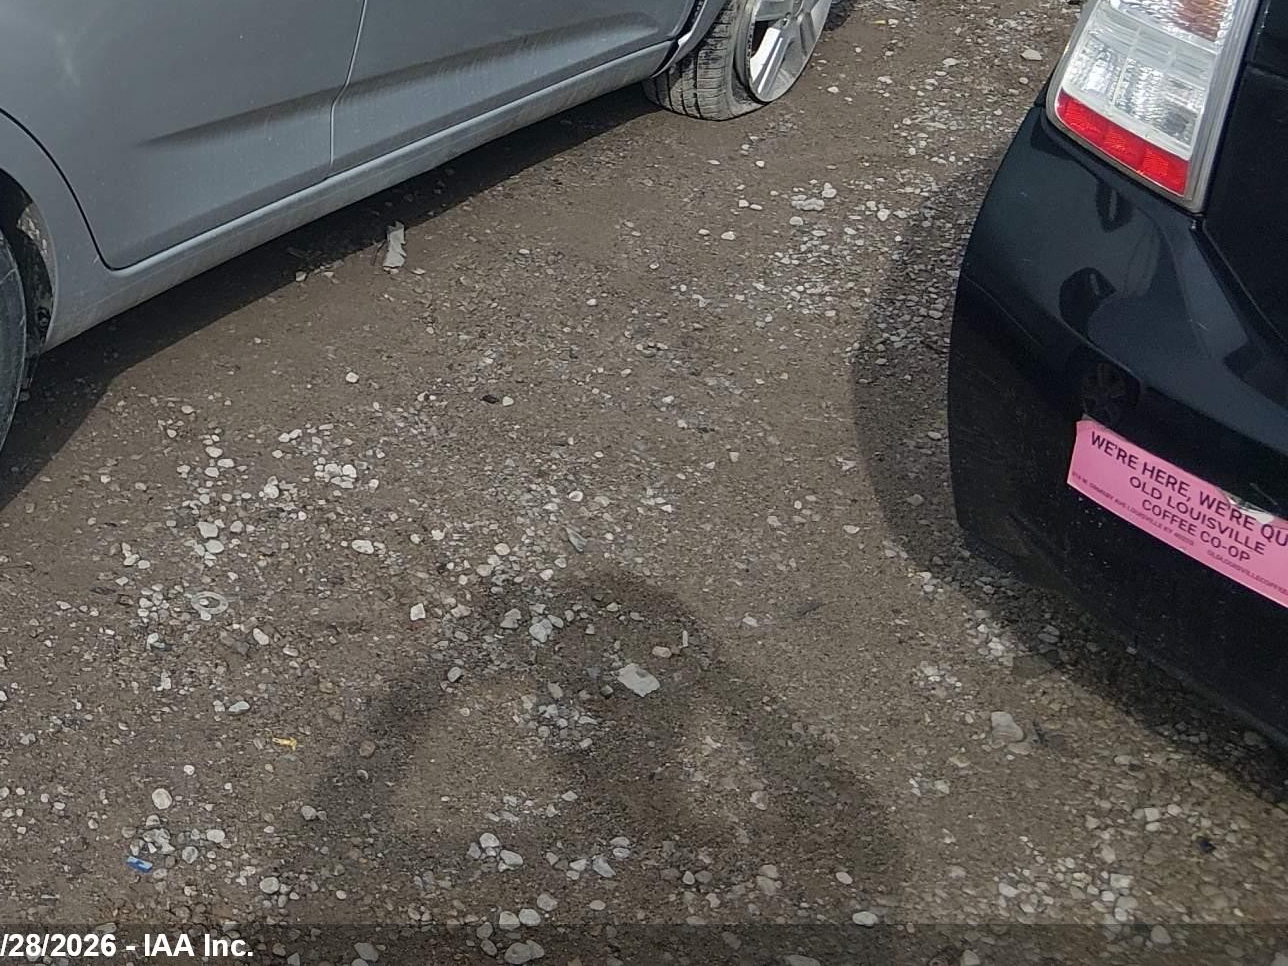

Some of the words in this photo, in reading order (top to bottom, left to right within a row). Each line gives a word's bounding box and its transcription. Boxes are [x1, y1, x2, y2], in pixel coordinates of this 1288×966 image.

[1091, 431, 1139, 470] WE'RE
[1142, 461, 1192, 503] HERE,
[1199, 490, 1257, 532] WE'RE
[1129, 475, 1163, 501] OLD
[1167, 496, 1267, 556] LOUISVILLE
[1141, 499, 1198, 537] COFFEE
[1199, 531, 1251, 562] CO-OP
